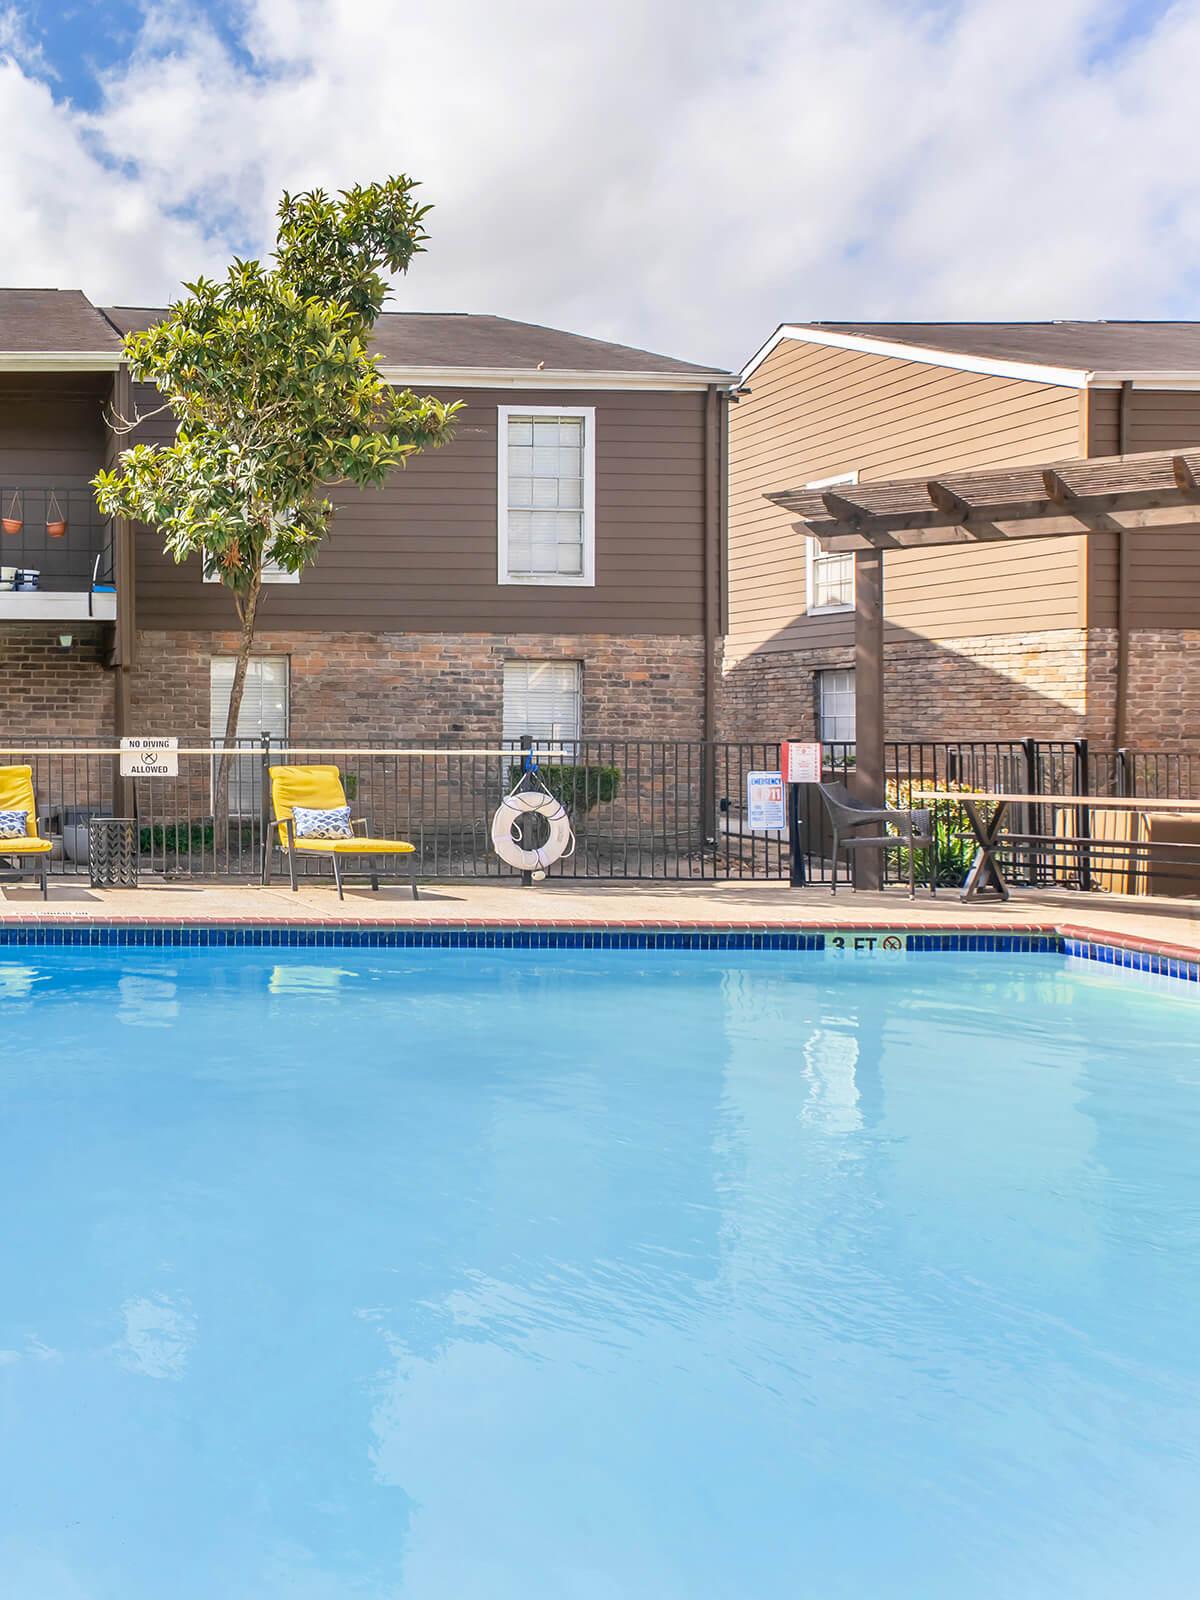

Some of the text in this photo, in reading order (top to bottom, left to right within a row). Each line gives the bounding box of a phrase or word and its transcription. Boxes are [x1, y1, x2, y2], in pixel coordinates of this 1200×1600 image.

[129, 740, 170, 748] NO DIVING
[131, 765, 168, 774] ALLOWED
[832, 936, 877, 950] 3 FT
